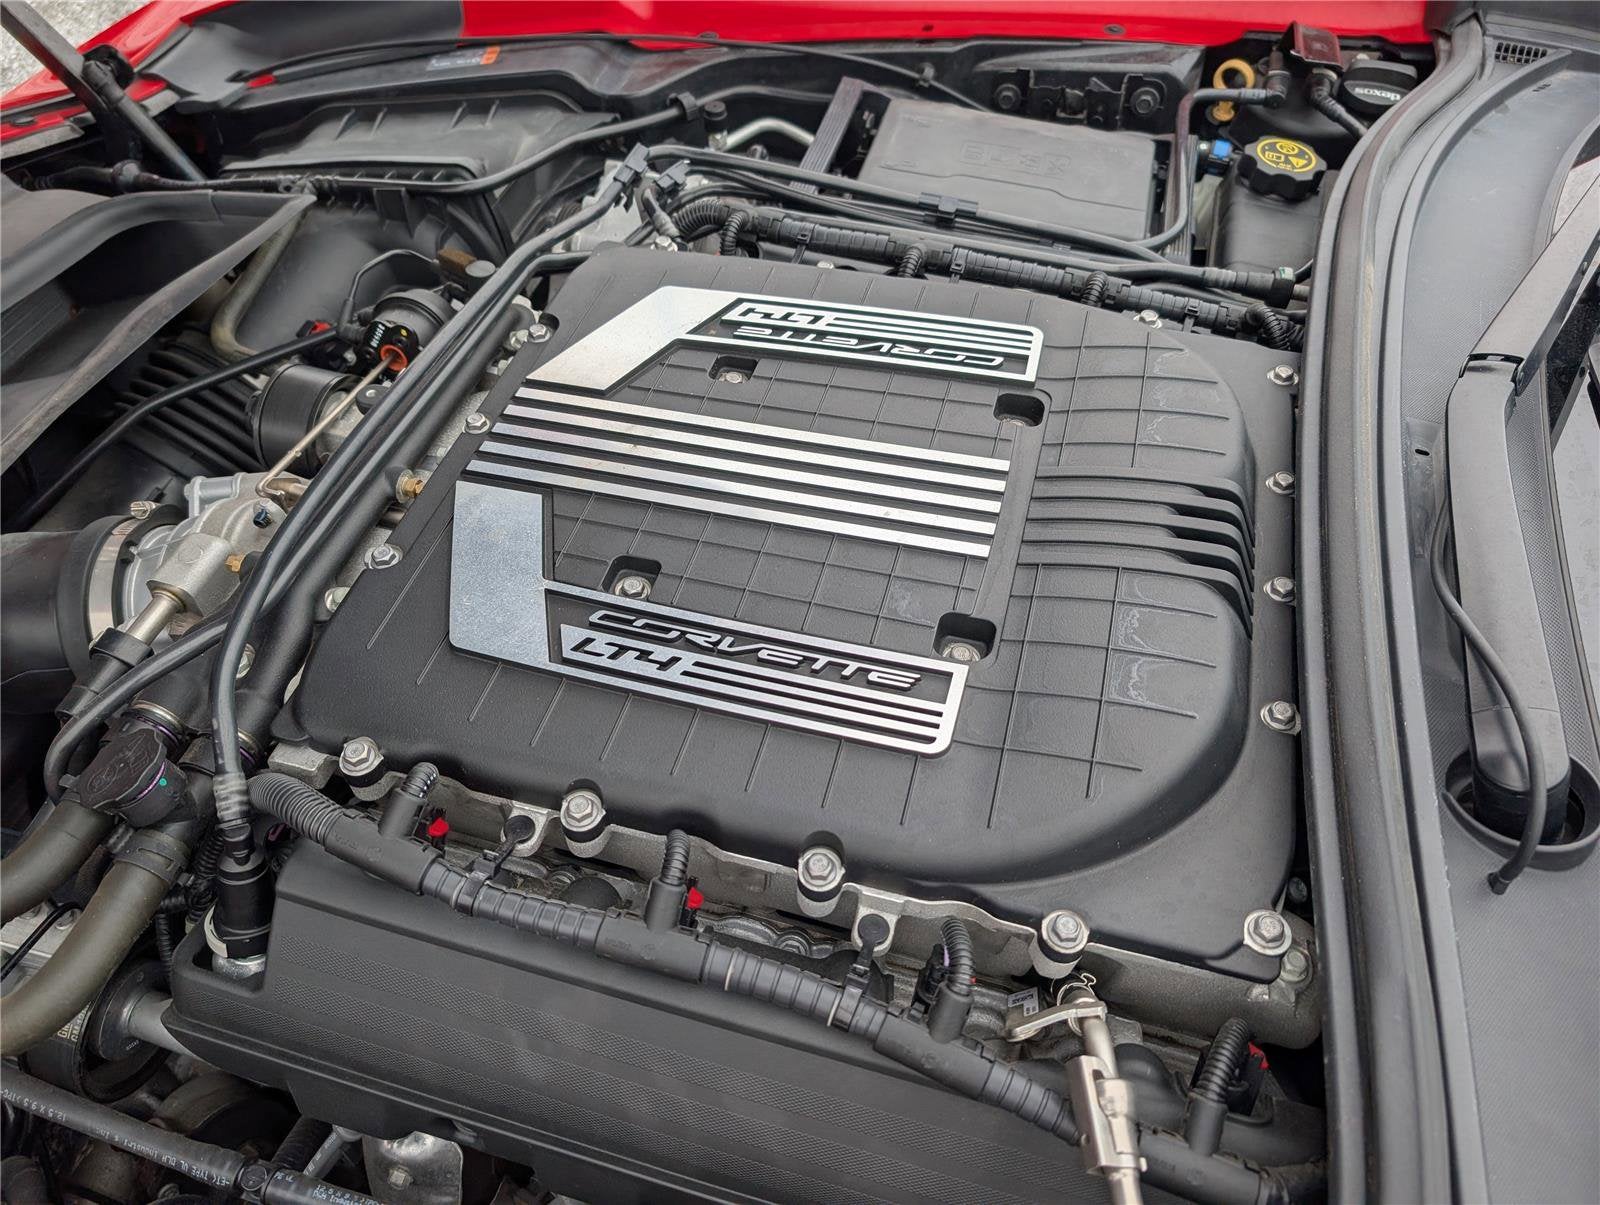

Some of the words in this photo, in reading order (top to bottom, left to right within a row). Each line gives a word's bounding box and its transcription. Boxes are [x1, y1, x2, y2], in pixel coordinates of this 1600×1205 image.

[1354, 87, 1401, 101] dexos
[738, 308, 825, 326] LT4
[734, 325, 1005, 367] CORVETTE
[570, 637, 682, 671] LT4
[588, 610, 922, 692] CORVETTE
[23, 1098, 38, 1110] 9.5
[48, 1109, 66, 1121] 12.5
[191, 1166, 209, 1180] TYPE
